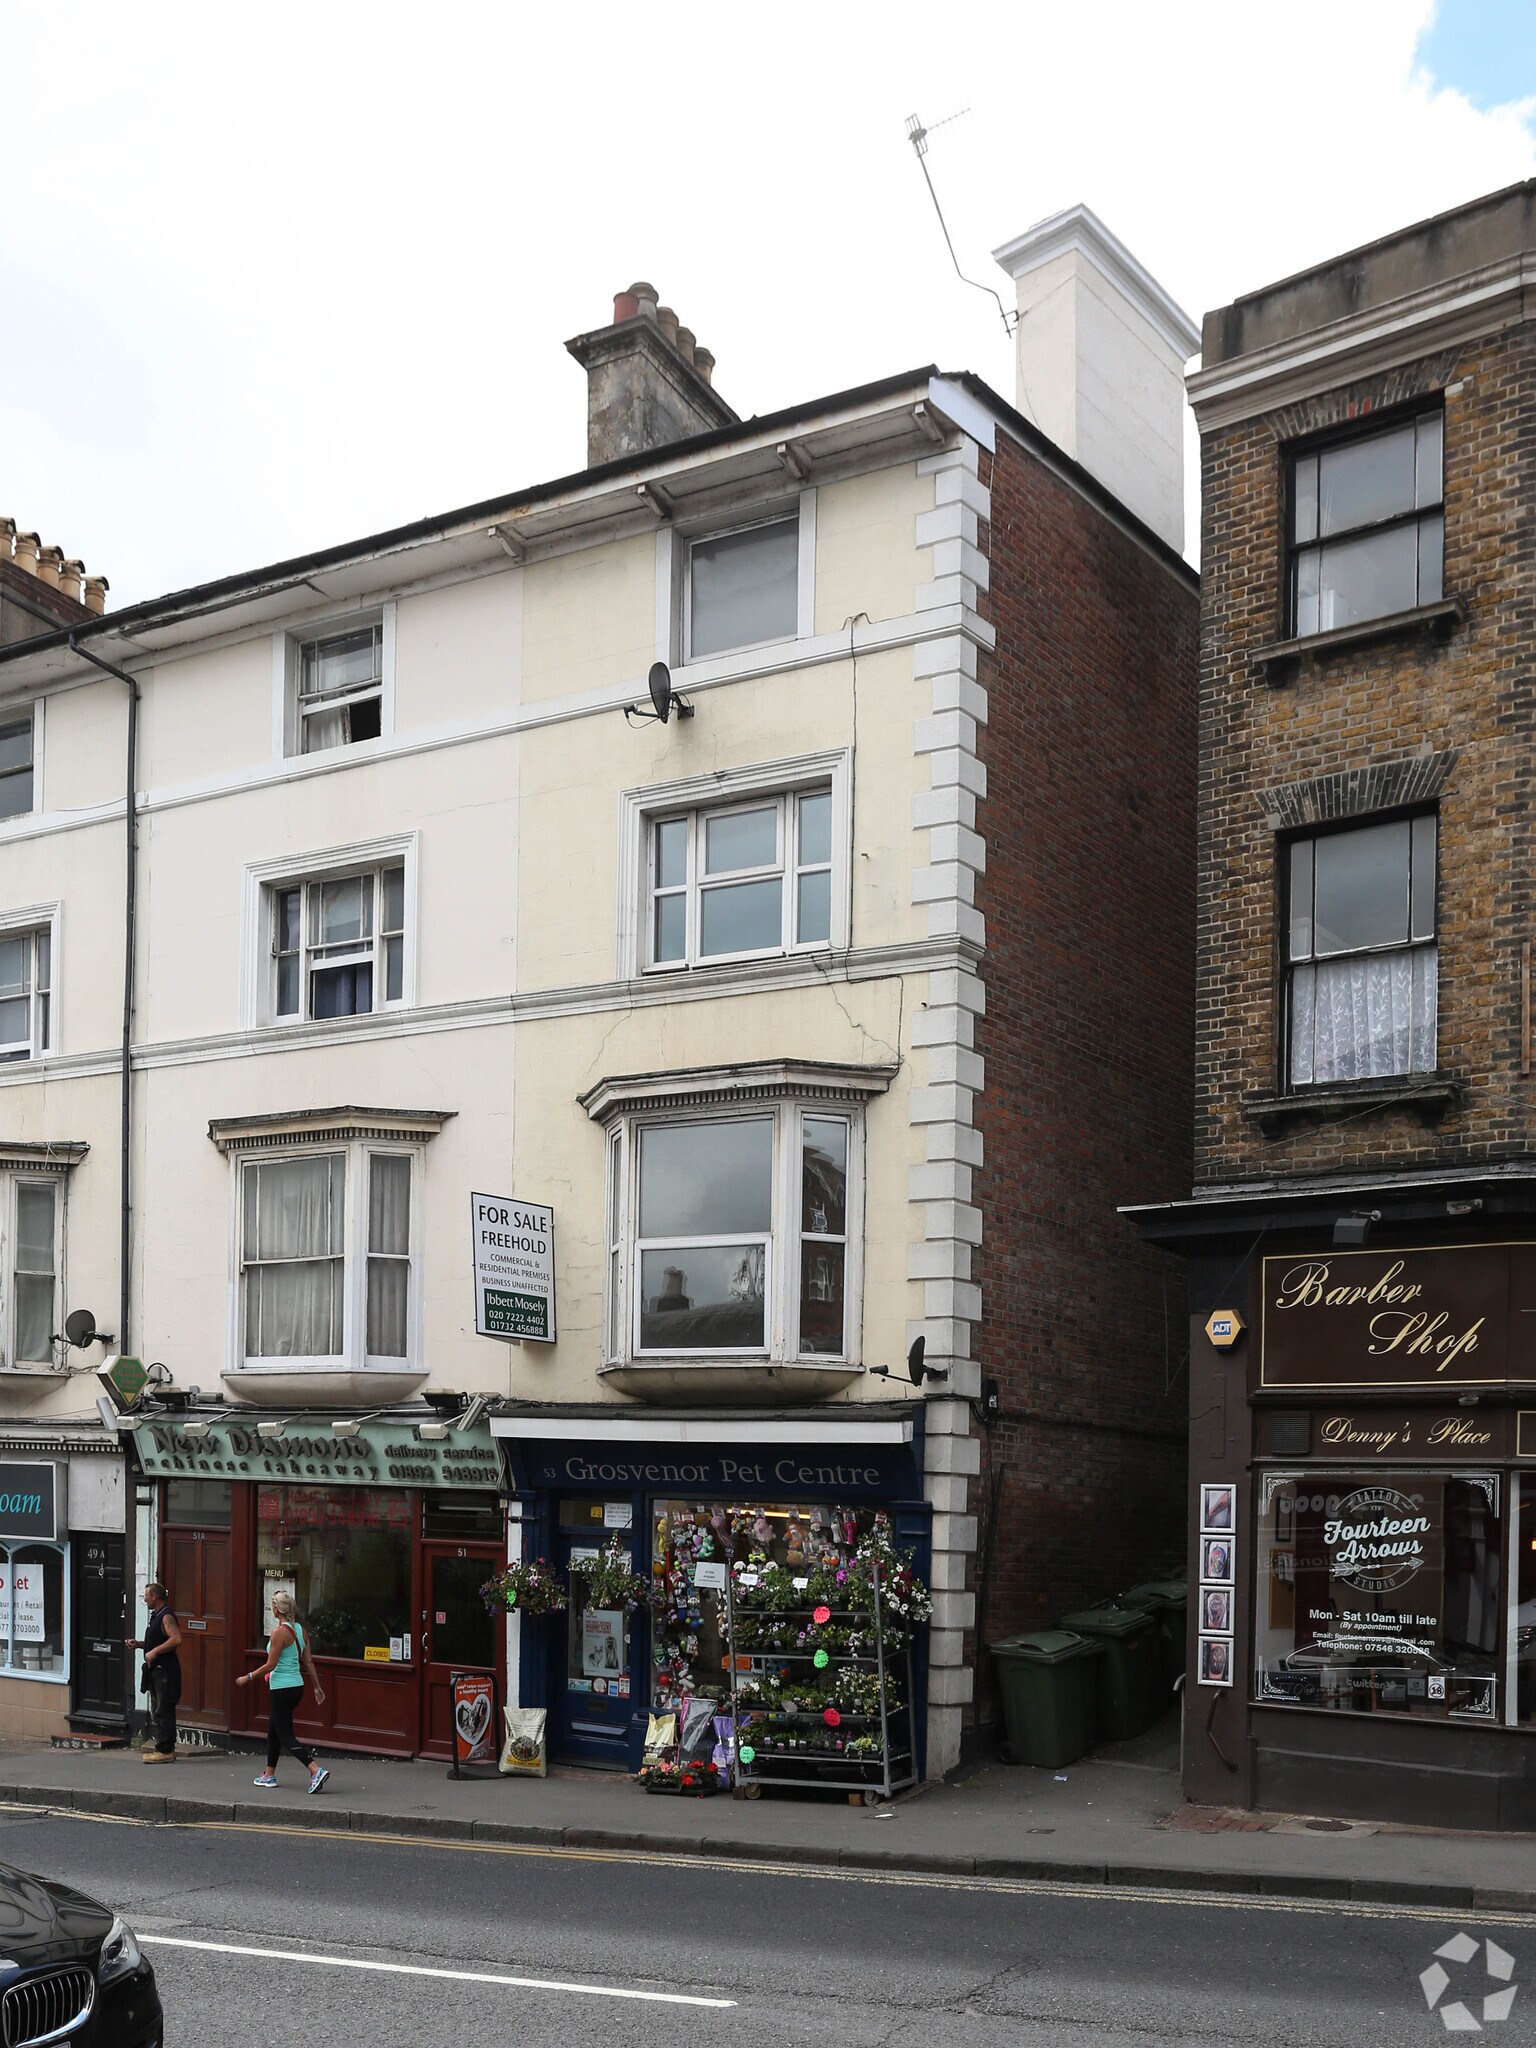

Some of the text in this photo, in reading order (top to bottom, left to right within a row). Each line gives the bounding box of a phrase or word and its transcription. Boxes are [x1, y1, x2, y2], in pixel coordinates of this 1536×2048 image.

[479, 1205, 548, 1233] FOR SALE
[481, 1230, 546, 1255] FREEHOLD
[490, 1253, 540, 1269] COMMERCIAL &
[479, 1262, 550, 1282] RESIDENTIAL PREMISES
[481, 1276, 549, 1294] BUSINESS UNAFFECTED
[1275, 1260, 1422, 1309] Barber
[486, 1292, 546, 1316] Ibbett Mosely
[488, 1309, 545, 1326] 020 7222 4402
[490, 1320, 544, 1336] 01732 456888
[1213, 1323, 1231, 1334] ADT
[1367, 1311, 1486, 1372] Shop
[148, 1425, 371, 1459] New Diamond
[1320, 1416, 1491, 1453] Denny's Place
[384, 1444, 494, 1461] delivery service
[160, 1455, 249, 1471] chinese
[263, 1458, 378, 1481] takeaway
[388, 1463, 498, 1482] 01892 548916
[543, 1457, 881, 1485] 53 Grosvenor Pet Centre
[1356, 1490, 1400, 1505] TATTOO
[1323, 1516, 1431, 1545] Fourteen
[87, 1548, 105, 1559] 49 A
[457, 1547, 467, 1557] 51
[1336, 1540, 1423, 1564] Arrows
[264, 1569, 284, 1578] MENU
[1353, 1576, 1397, 1590] STUDIO
[1309, 1609, 1333, 1620] Mon
[1342, 1611, 1361, 1622] Sat
[1365, 1612, 1396, 1624] 10am
[1398, 1614, 1413, 1624] till
[1416, 1615, 1437, 1625] late
[1339, 1621, 1402, 1632] (By appointment)
[1312, 1631, 1333, 1640] Email:
[366, 1650, 388, 1658] CLOSED
[1317, 1640, 1362, 1651] Telephone:
[1364, 1643, 1393, 1653] 07546
[1346, 1678, 1385, 1689] twitter
[1431, 1686, 1442, 1695] 18
